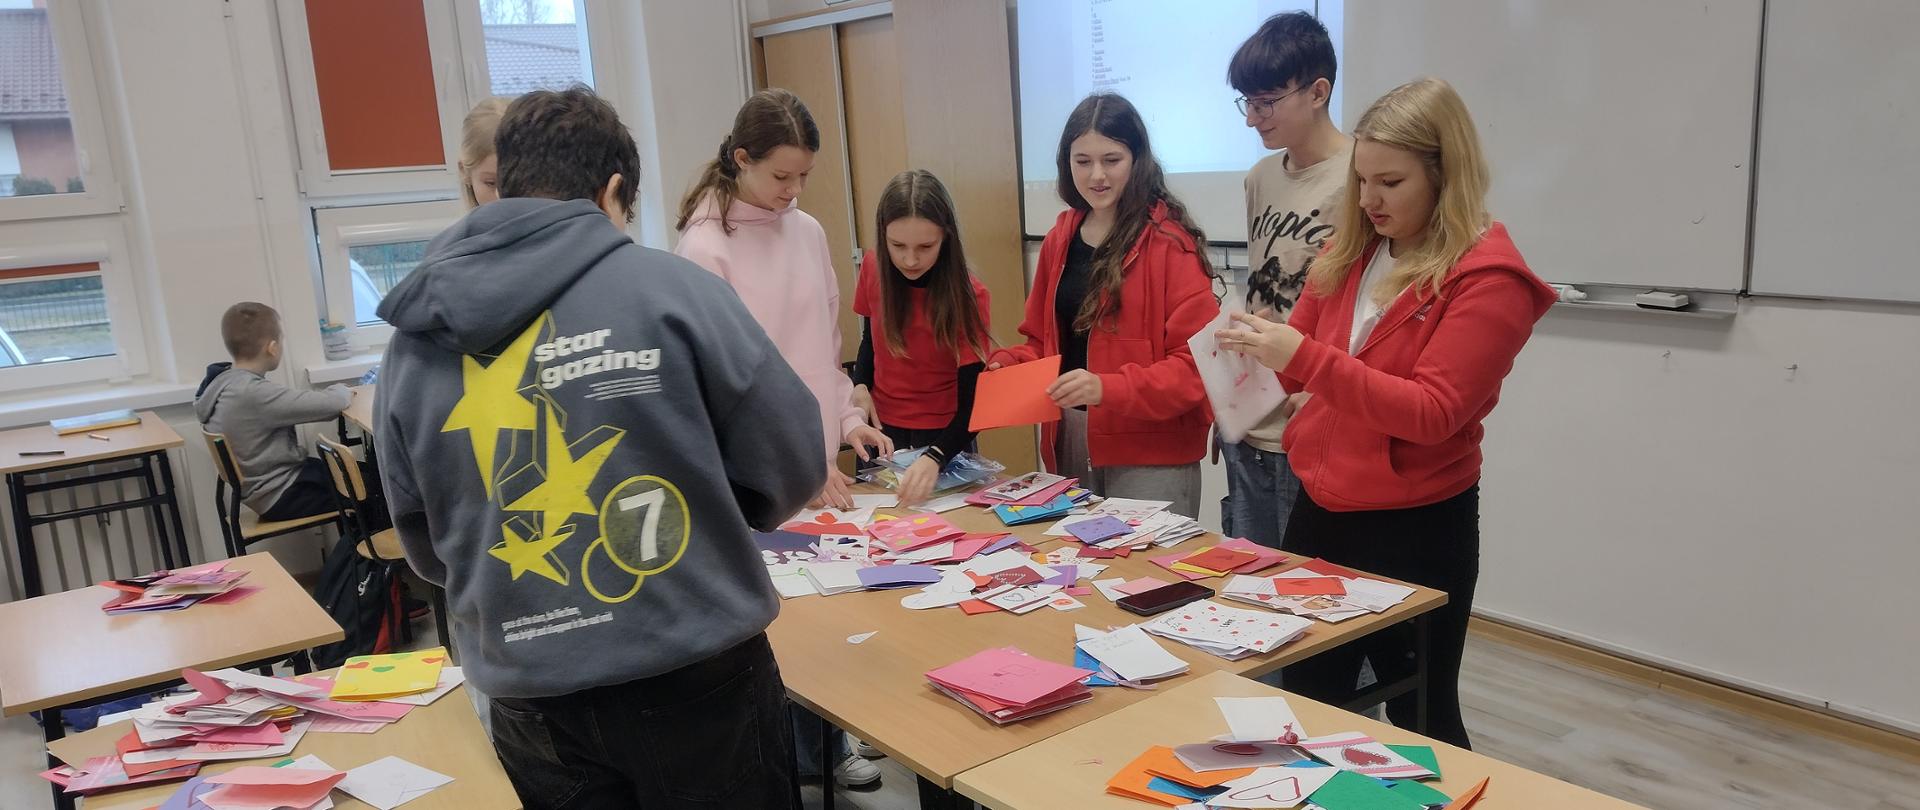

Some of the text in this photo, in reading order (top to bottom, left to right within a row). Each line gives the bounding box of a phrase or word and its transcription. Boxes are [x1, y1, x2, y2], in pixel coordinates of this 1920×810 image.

[534, 328, 612, 362] star
[541, 348, 662, 390] gazing
[618, 487, 666, 562] 7
